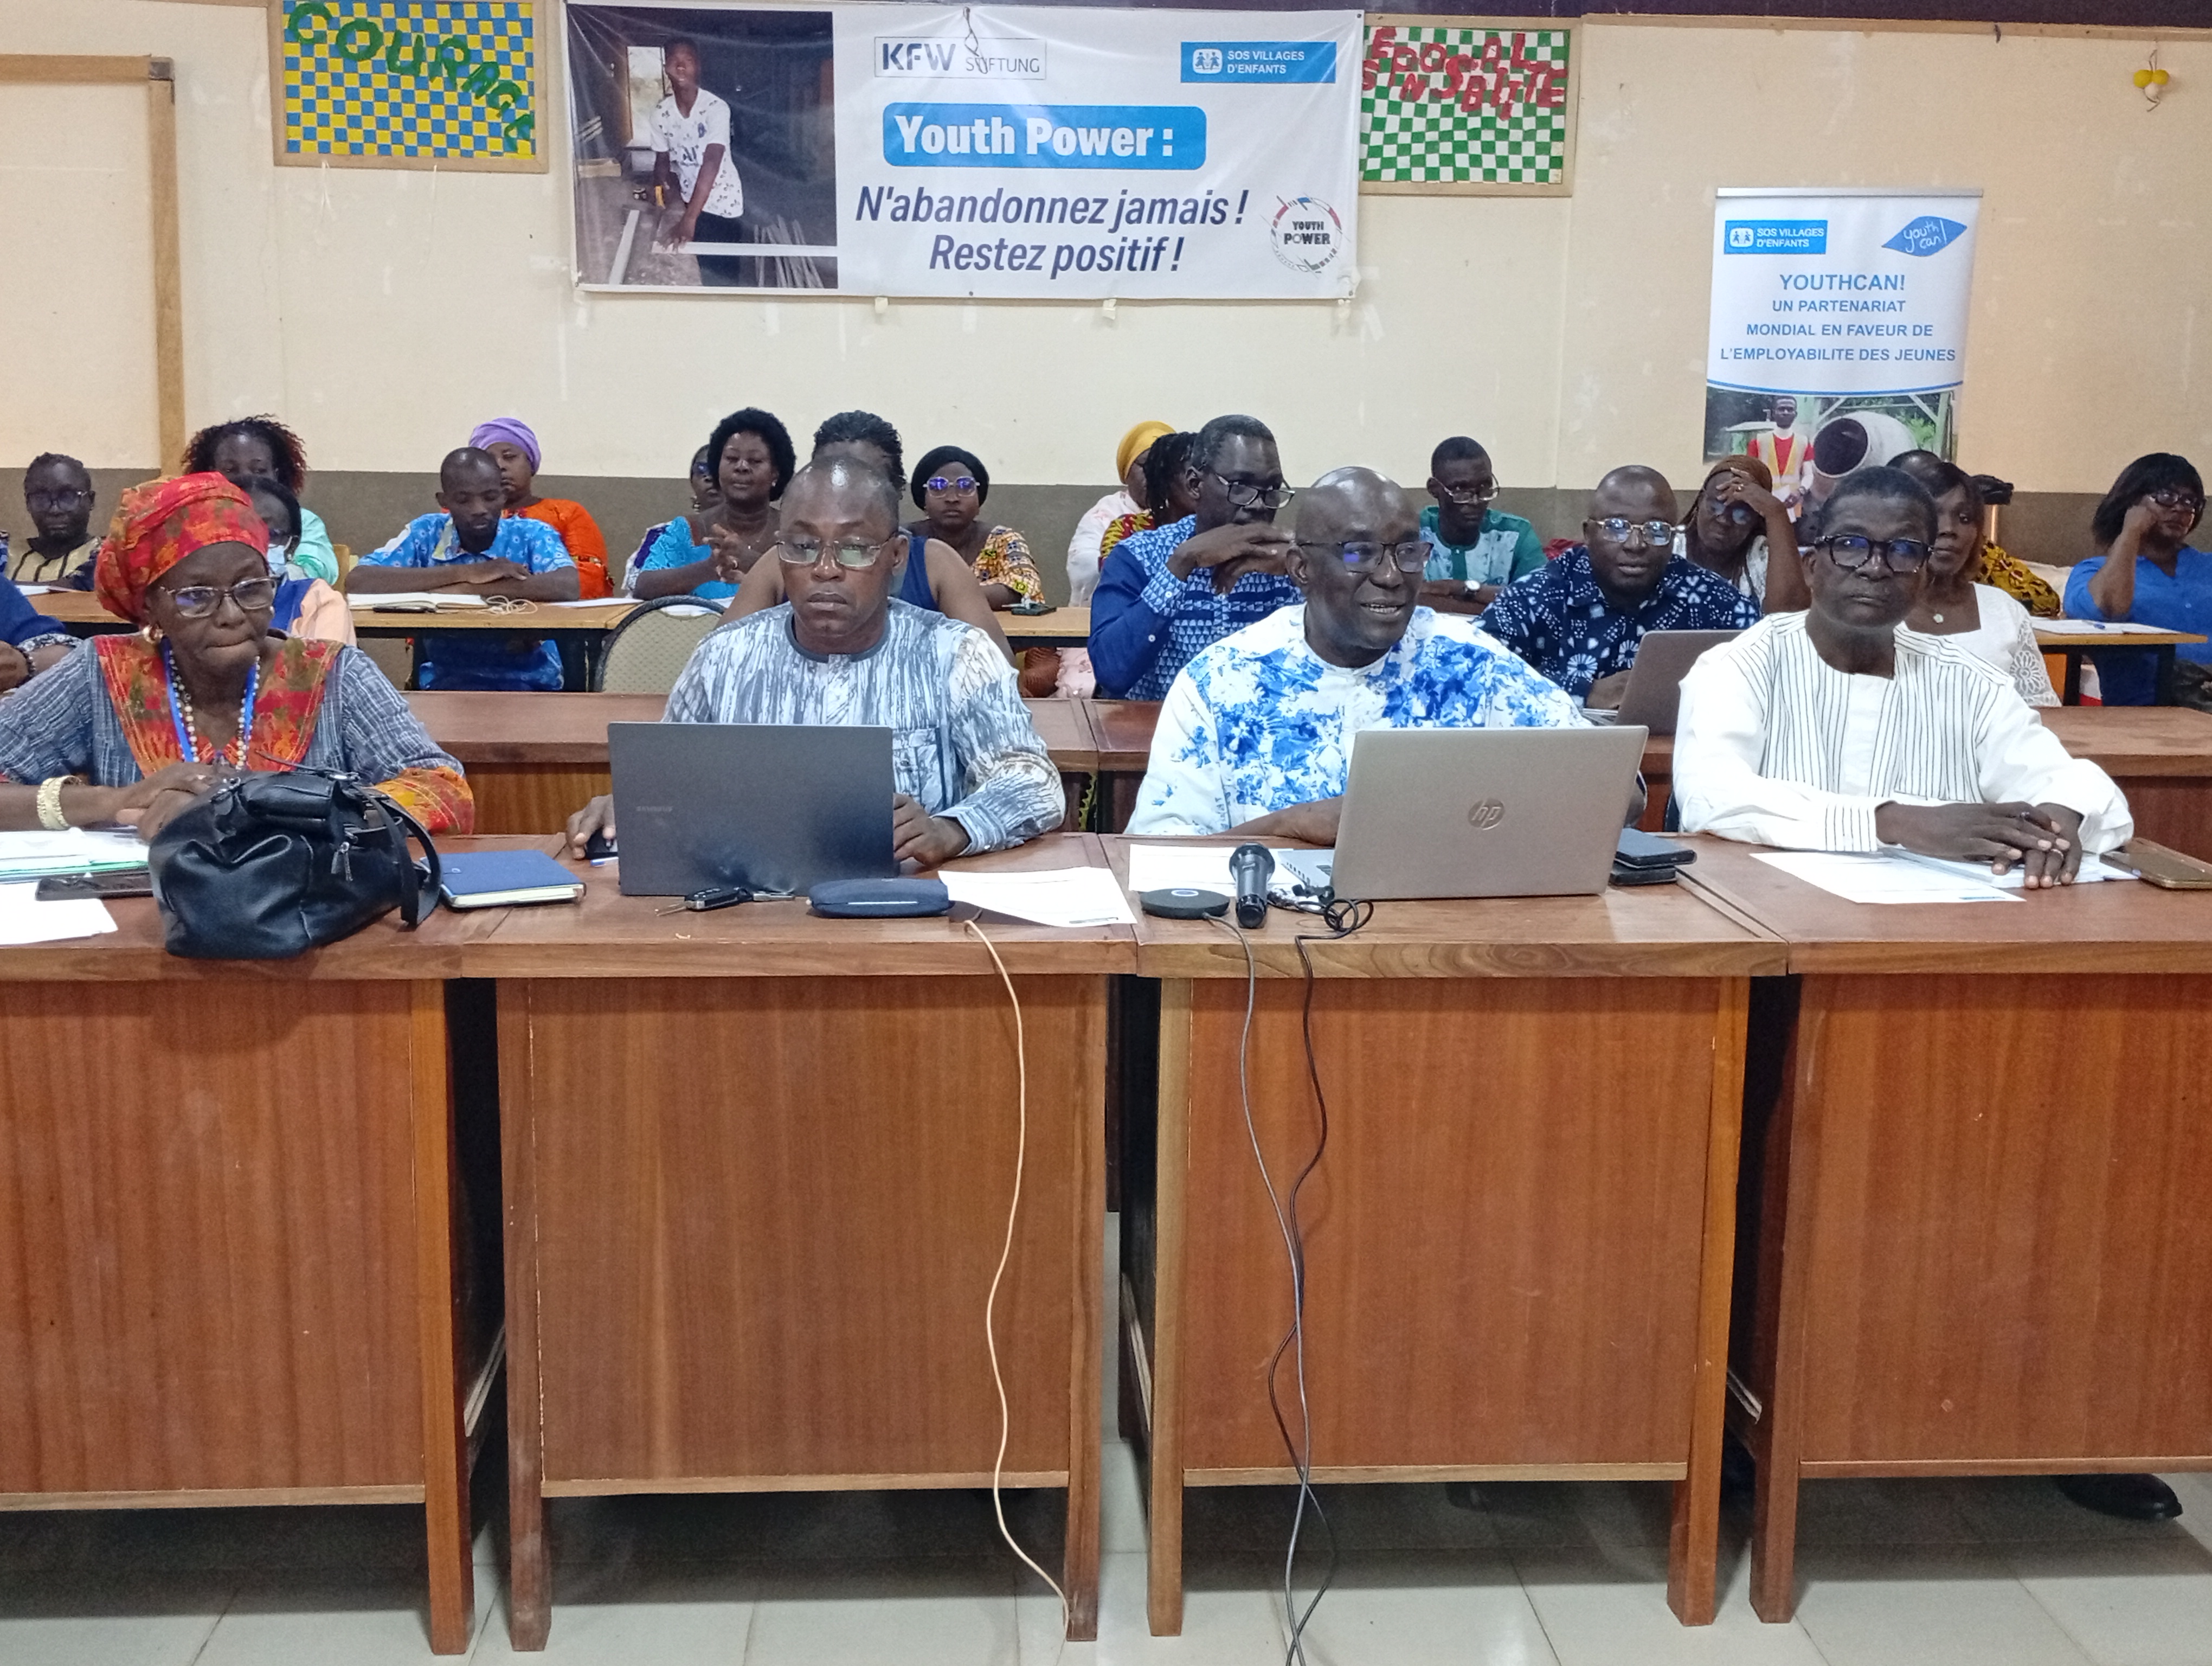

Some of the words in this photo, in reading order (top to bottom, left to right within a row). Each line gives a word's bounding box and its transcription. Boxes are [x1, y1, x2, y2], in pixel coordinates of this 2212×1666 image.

[882, 43, 956, 71] KFW
[1227, 50, 1250, 60] SOS
[1252, 50, 1305, 61] VILLAGES
[1227, 64, 1287, 74] D'ENFANTS
[893, 114, 1015, 155] Youth
[1026, 117, 1154, 157] Power
[855, 185, 1109, 225] N'abandonnez
[1107, 189, 1229, 234] jamais
[1292, 221, 1324, 230] YOUTH
[1283, 233, 1330, 245] POWER
[1756, 228, 1777, 237] SOS
[1779, 228, 1824, 238] VILLAGES
[1903, 221, 1939, 253] youth
[1756, 239, 1810, 248] D'ENFANTS
[929, 234, 1047, 271] Restez
[1049, 236, 1170, 280] positif
[1779, 274, 1905, 291] YOUTHCAN!
[1772, 300, 1793, 312] UN
[1798, 300, 1906, 312] PARTENARIAT
[1746, 323, 1816, 336] MONDIAL
[1821, 324, 1842, 336] EN
[1847, 324, 1908, 337] FAVEUR
[1912, 324, 1934, 337] DE
[1720, 348, 1854, 361] L'EMPLOYABILITE
[1859, 348, 1890, 361] DES
[1894, 348, 1956, 362] JEUNES
[1470, 799, 1503, 829] hp
